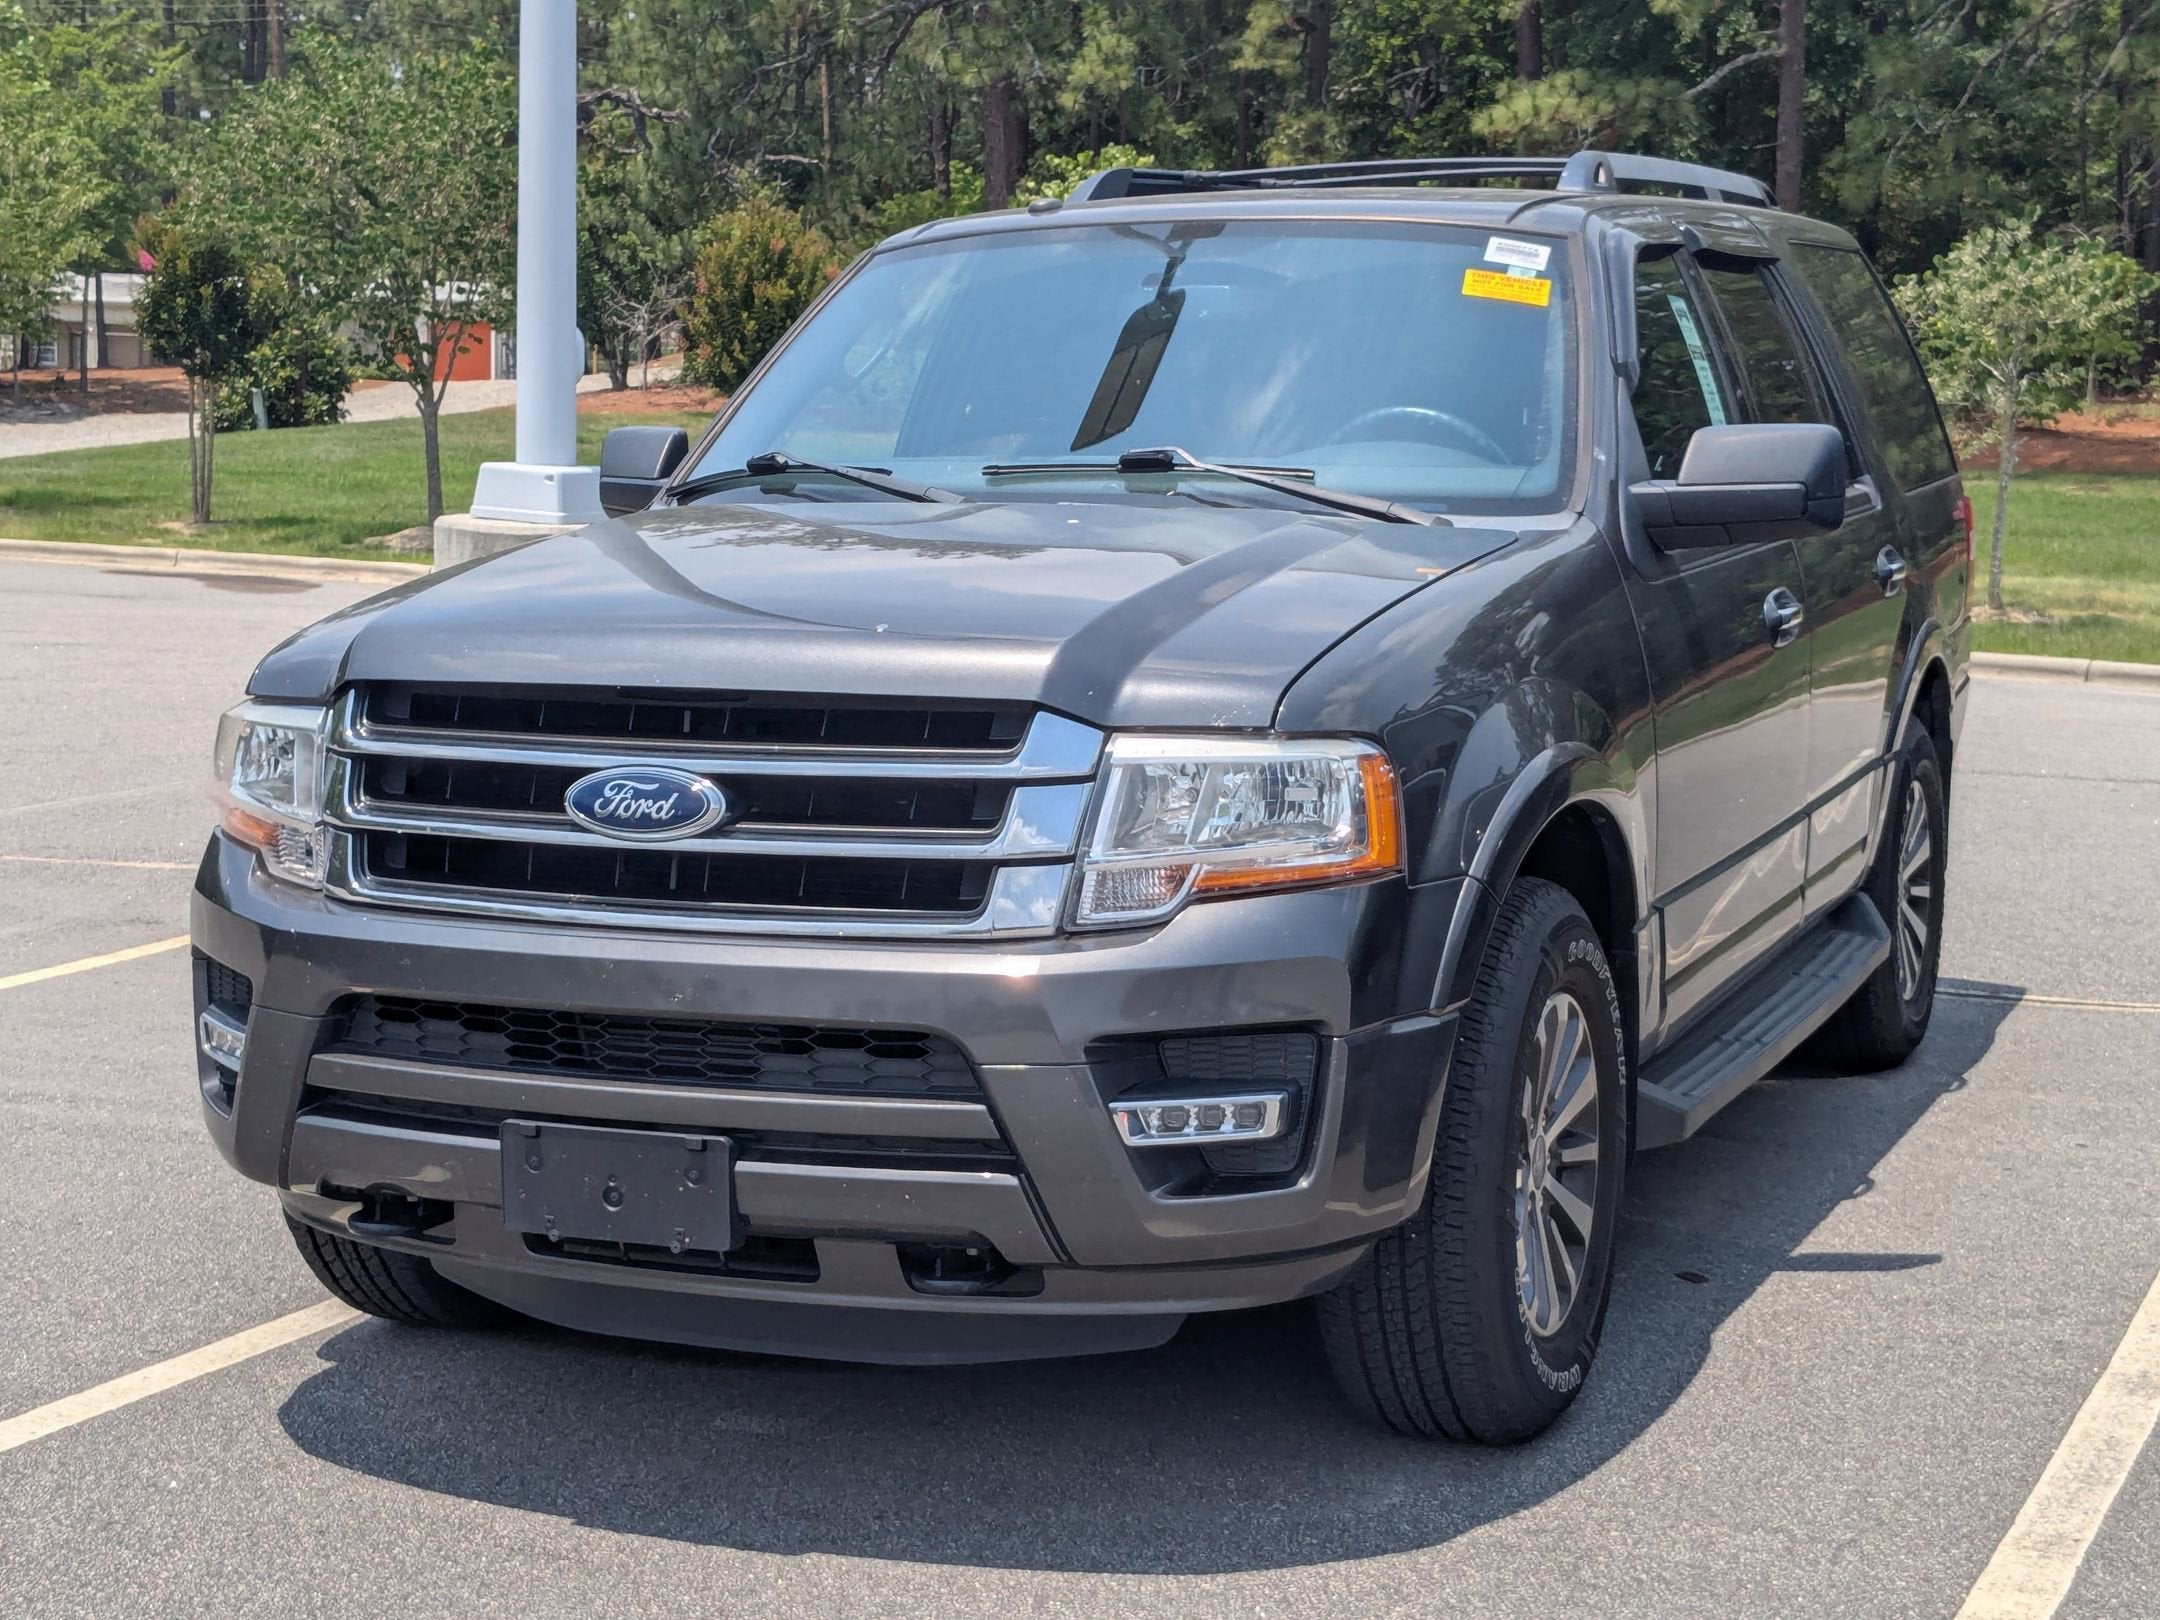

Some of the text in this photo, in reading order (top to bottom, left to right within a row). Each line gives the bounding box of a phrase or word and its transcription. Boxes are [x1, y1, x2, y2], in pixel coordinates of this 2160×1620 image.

[1472, 272, 1545, 288] THIS VEHICLE
[1494, 281, 1515, 289] FOR
[1518, 284, 1543, 293] SALE
[594, 779, 680, 821] Ford
[1568, 939, 1627, 1085] GOODYEAR
